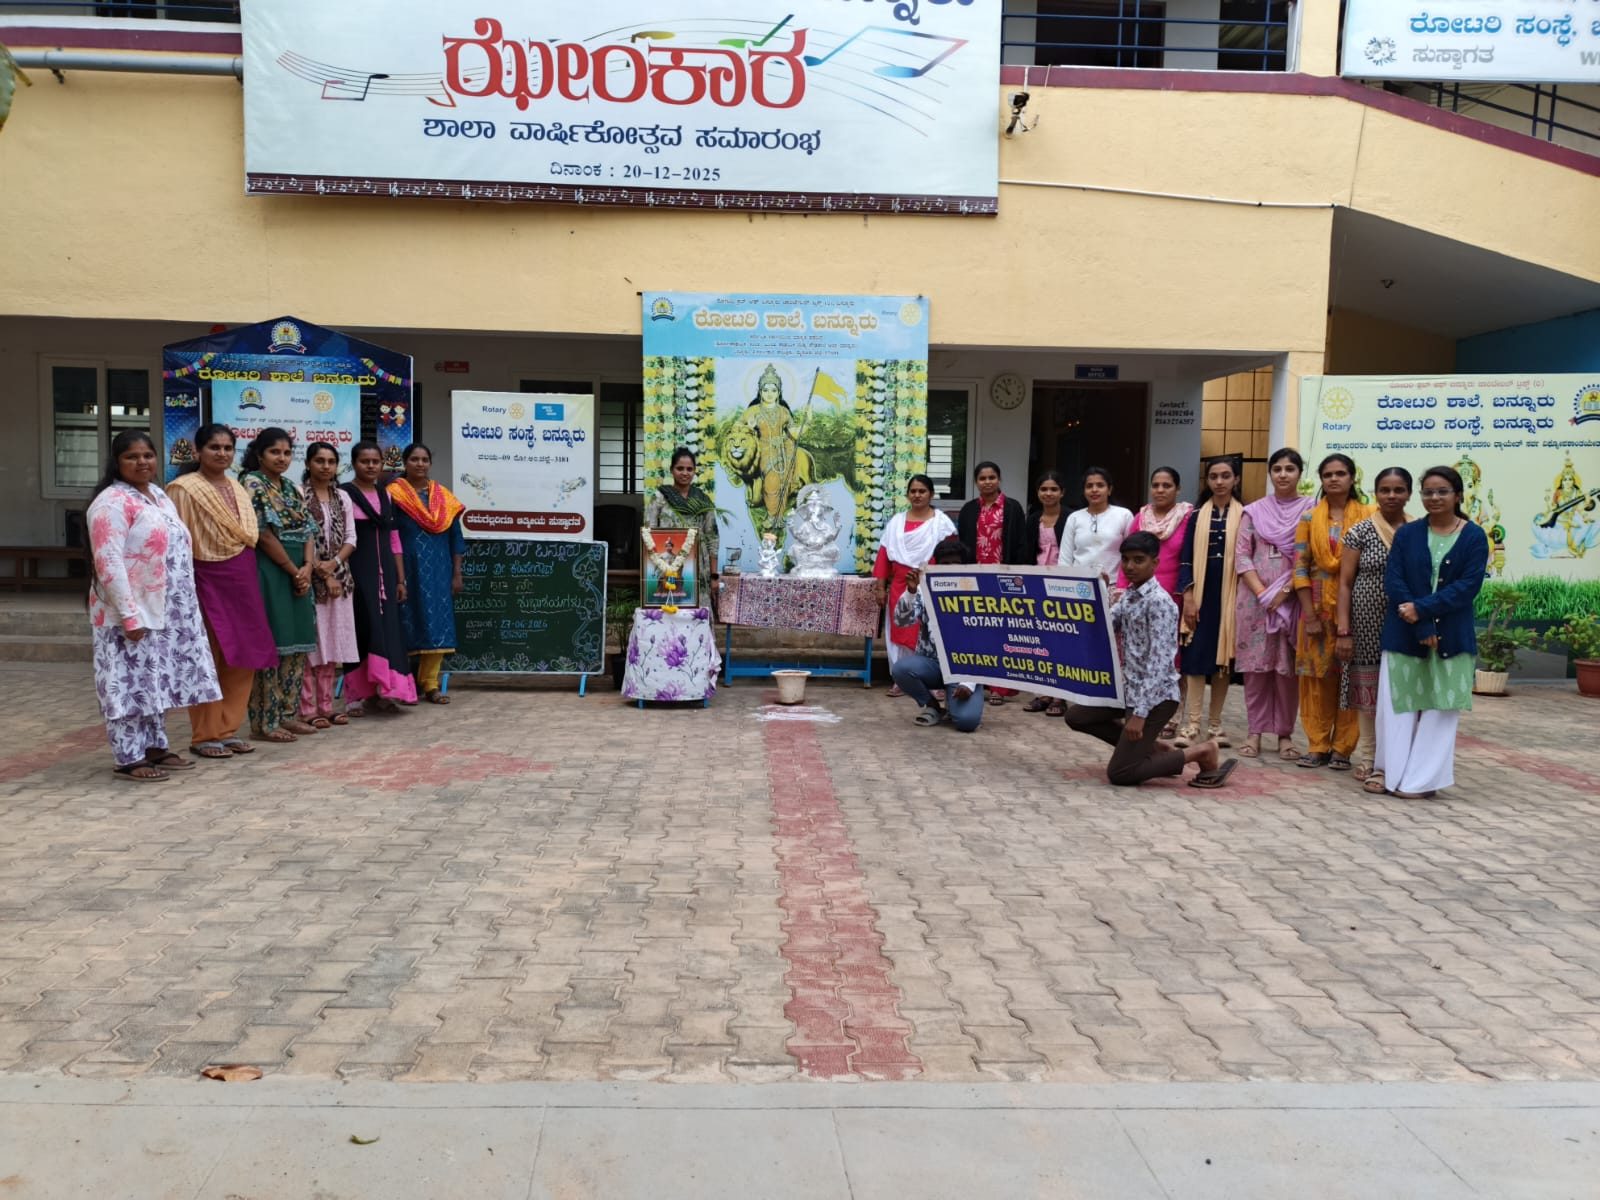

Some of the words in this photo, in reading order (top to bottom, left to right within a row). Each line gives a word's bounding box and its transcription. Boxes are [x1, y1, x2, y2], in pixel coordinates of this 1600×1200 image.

[1409, 12, 1502, 35] ರೋಟರಿ
[442, 17, 808, 111] ಝೇಂಕಾರ
[1412, 44, 1495, 70] ಸುಸ್ವಾಗತ
[423, 118, 496, 139] ಶಾಲಾ
[510, 120, 682, 154] ವಾರ್ಷಿಕೋತ್ಸವ
[695, 128, 821, 155] ಸಮಾರಂಭ
[550, 161, 602, 177] ದಿನಾಂಕ
[623, 164, 721, 182] 20-12-2025
[694, 308, 757, 328] ರೋಟರಿ
[813, 315, 877, 336] ಬನ್ನೂರು
[198, 368, 260, 381] ರೋಟರಿ
[482, 405, 507, 415] Rotary
[1377, 395, 1437, 408] ರೋಟರಿ
[1493, 395, 1555, 412] ಬನ್ನೂರು
[1322, 423, 1352, 433] Rotary
[1377, 416, 1435, 430] ರೋಟರಿ
[1493, 418, 1554, 434] ಬನ್ನೂರು
[461, 422, 503, 440] ರೋಟರಿ
[542, 427, 586, 448] ಬನ್ನೂರು
[934, 580, 958, 588] Rotary
[1048, 584, 1075, 593] Interact
[938, 596, 1035, 616] INTERACT
[1043, 600, 1096, 623] CLUB
[963, 616, 1003, 628] ROTARY
[1007, 618, 1034, 630] HIGH
[1035, 620, 1079, 634] SCHOOL
[1008, 633, 1040, 645] BANNUR
[951, 652, 998, 667] ROTARY
[1002, 656, 1035, 671] CLUB
[1038, 660, 1053, 674] OF
[1057, 664, 1111, 685] BANNUR
